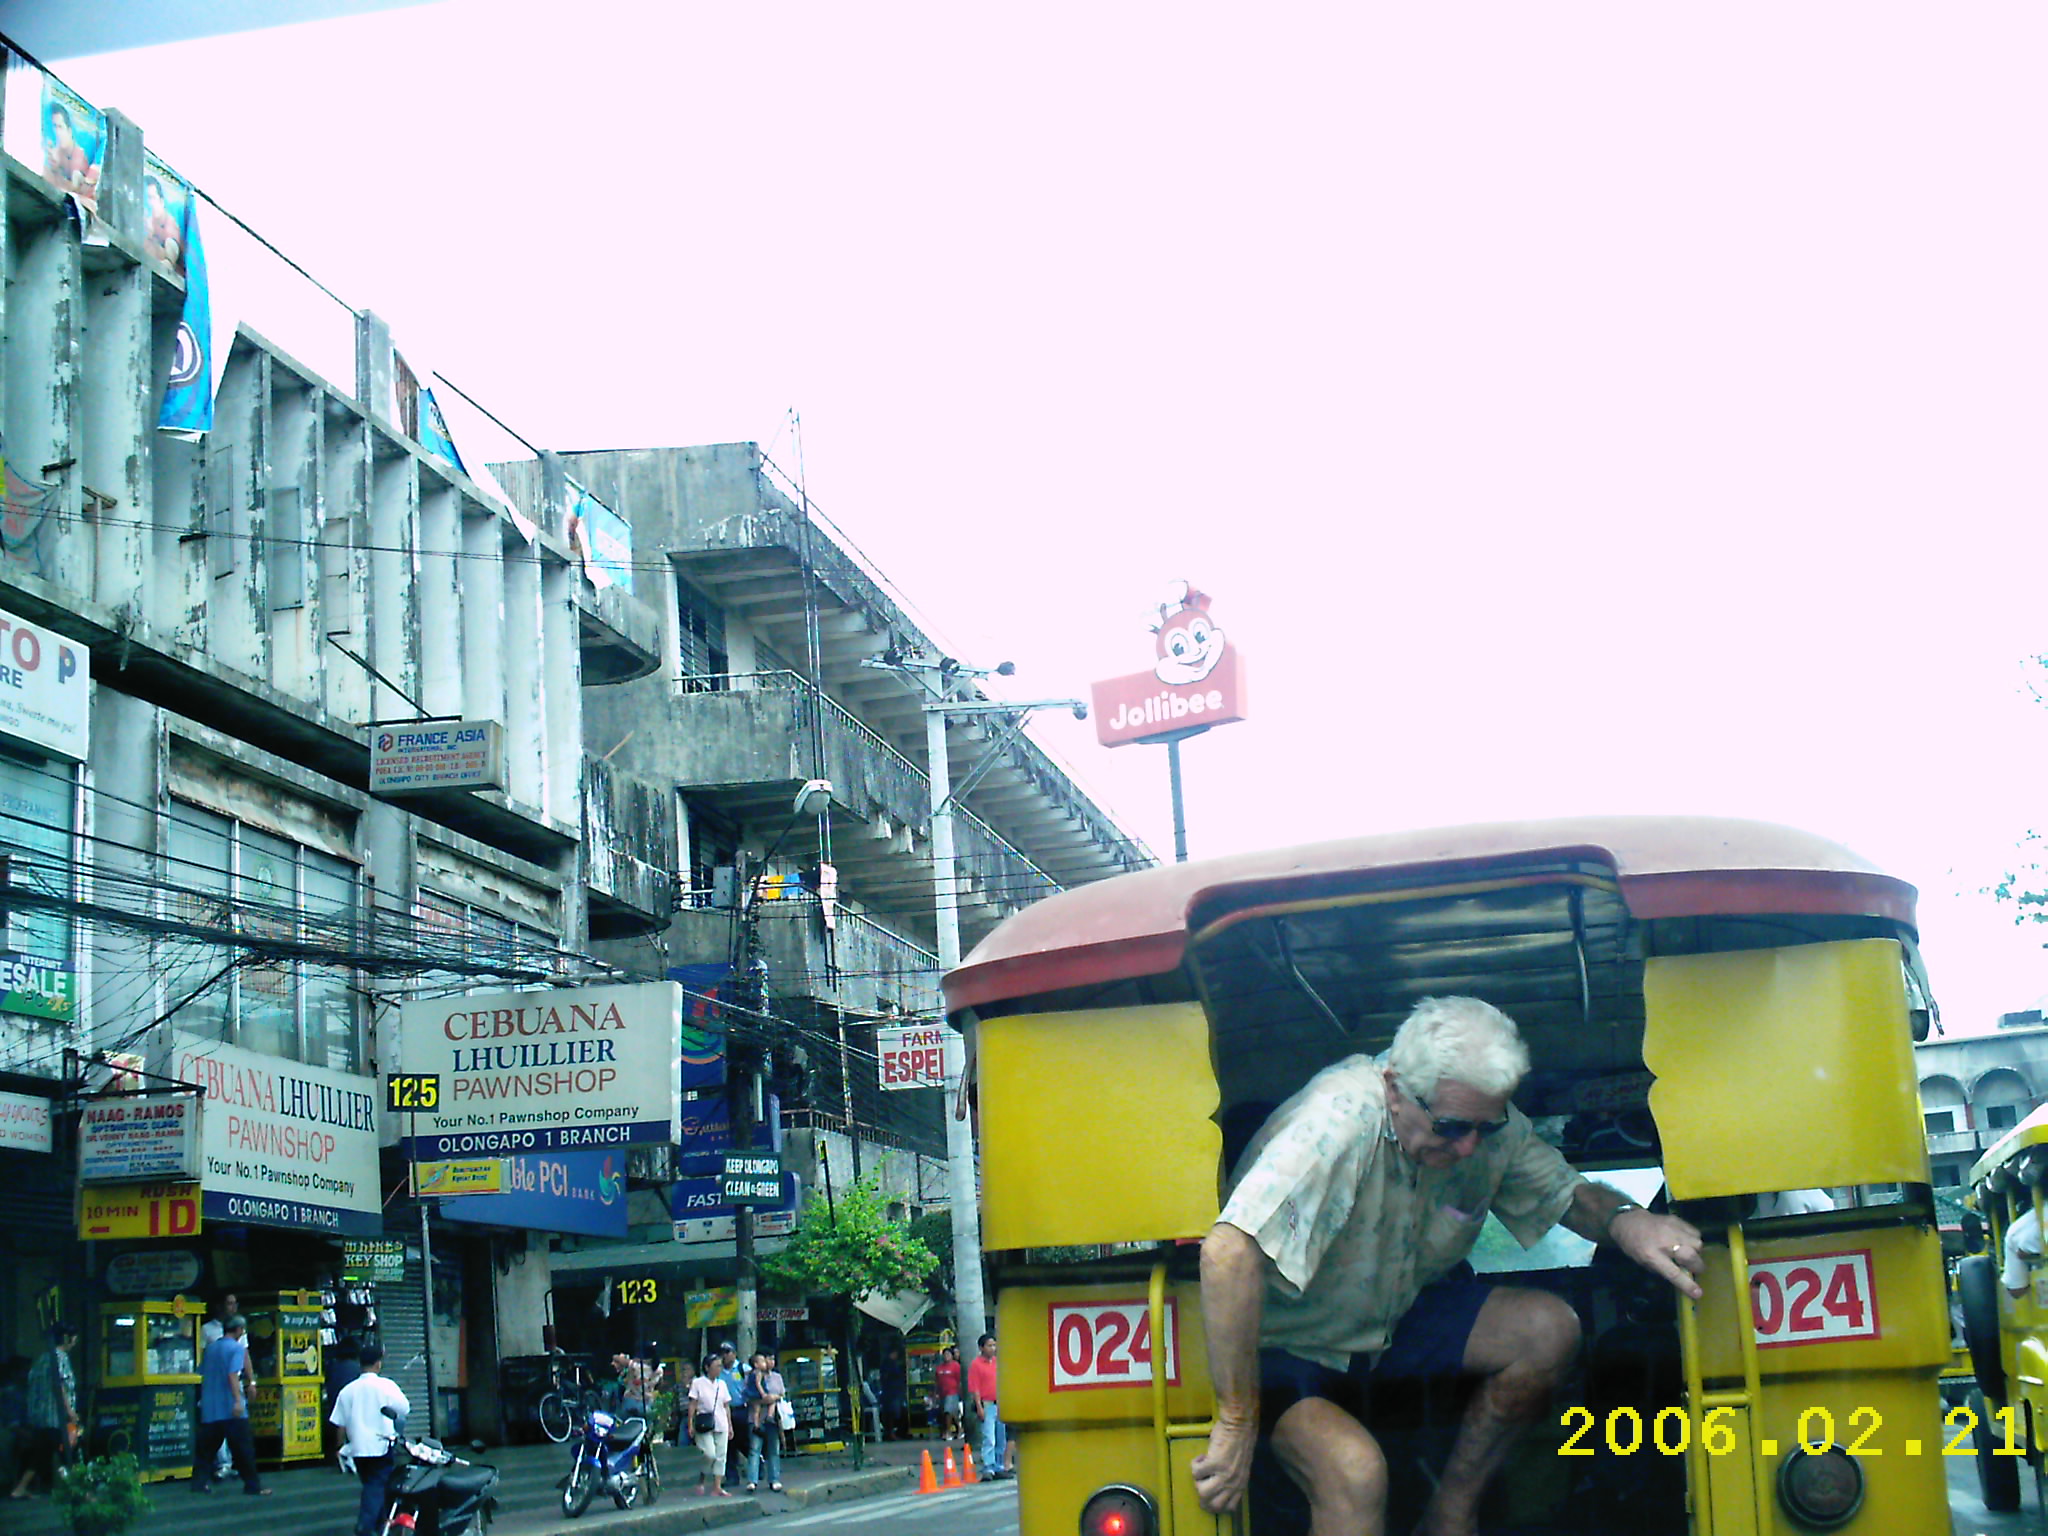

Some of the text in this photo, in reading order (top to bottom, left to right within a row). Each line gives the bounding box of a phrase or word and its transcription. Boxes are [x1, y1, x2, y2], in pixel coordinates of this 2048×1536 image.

[1110, 690, 1224, 730] Jollibee
[398, 729, 485, 746] FRANCE ASIA
[21, 955, 63, 970] INTERNET
[0, 960, 67, 998] ESALE
[444, 1002, 626, 1041] CEBUANA
[452, 1038, 616, 1072] LHUILLIER
[179, 1053, 276, 1112] CEBUANA
[279, 1076, 374, 1132] LHUILLIER
[389, 1077, 437, 1107] 125
[453, 1068, 616, 1100] PAWNSHOP
[433, 1116, 463, 1128] Your
[500, 1110, 570, 1125] Pawnshop
[574, 1106, 639, 1121] Company
[229, 1116, 335, 1164] PAWNSHOP
[438, 1127, 630, 1153] OLONGAPO 1 BRANCH
[207, 1156, 232, 1175] Your
[261, 1165, 310, 1191] Pawnshop
[312, 1175, 355, 1198] Company
[540, 1160, 568, 1197] PCI
[726, 1159, 743, 1173] KEEP
[140, 1185, 194, 1198] RUSH
[725, 1181, 750, 1196] CLEAN
[757, 1181, 779, 1197] GREEN
[87, 1199, 196, 1236] 10 MIN ID
[228, 1198, 338, 1227] OLONGAPO 1 BRANCH
[345, 1254, 404, 1267] KEY SHOP
[617, 1279, 657, 1304] 123
[1748, 1263, 1864, 1336] 024
[1057, 1310, 1168, 1376] 024
